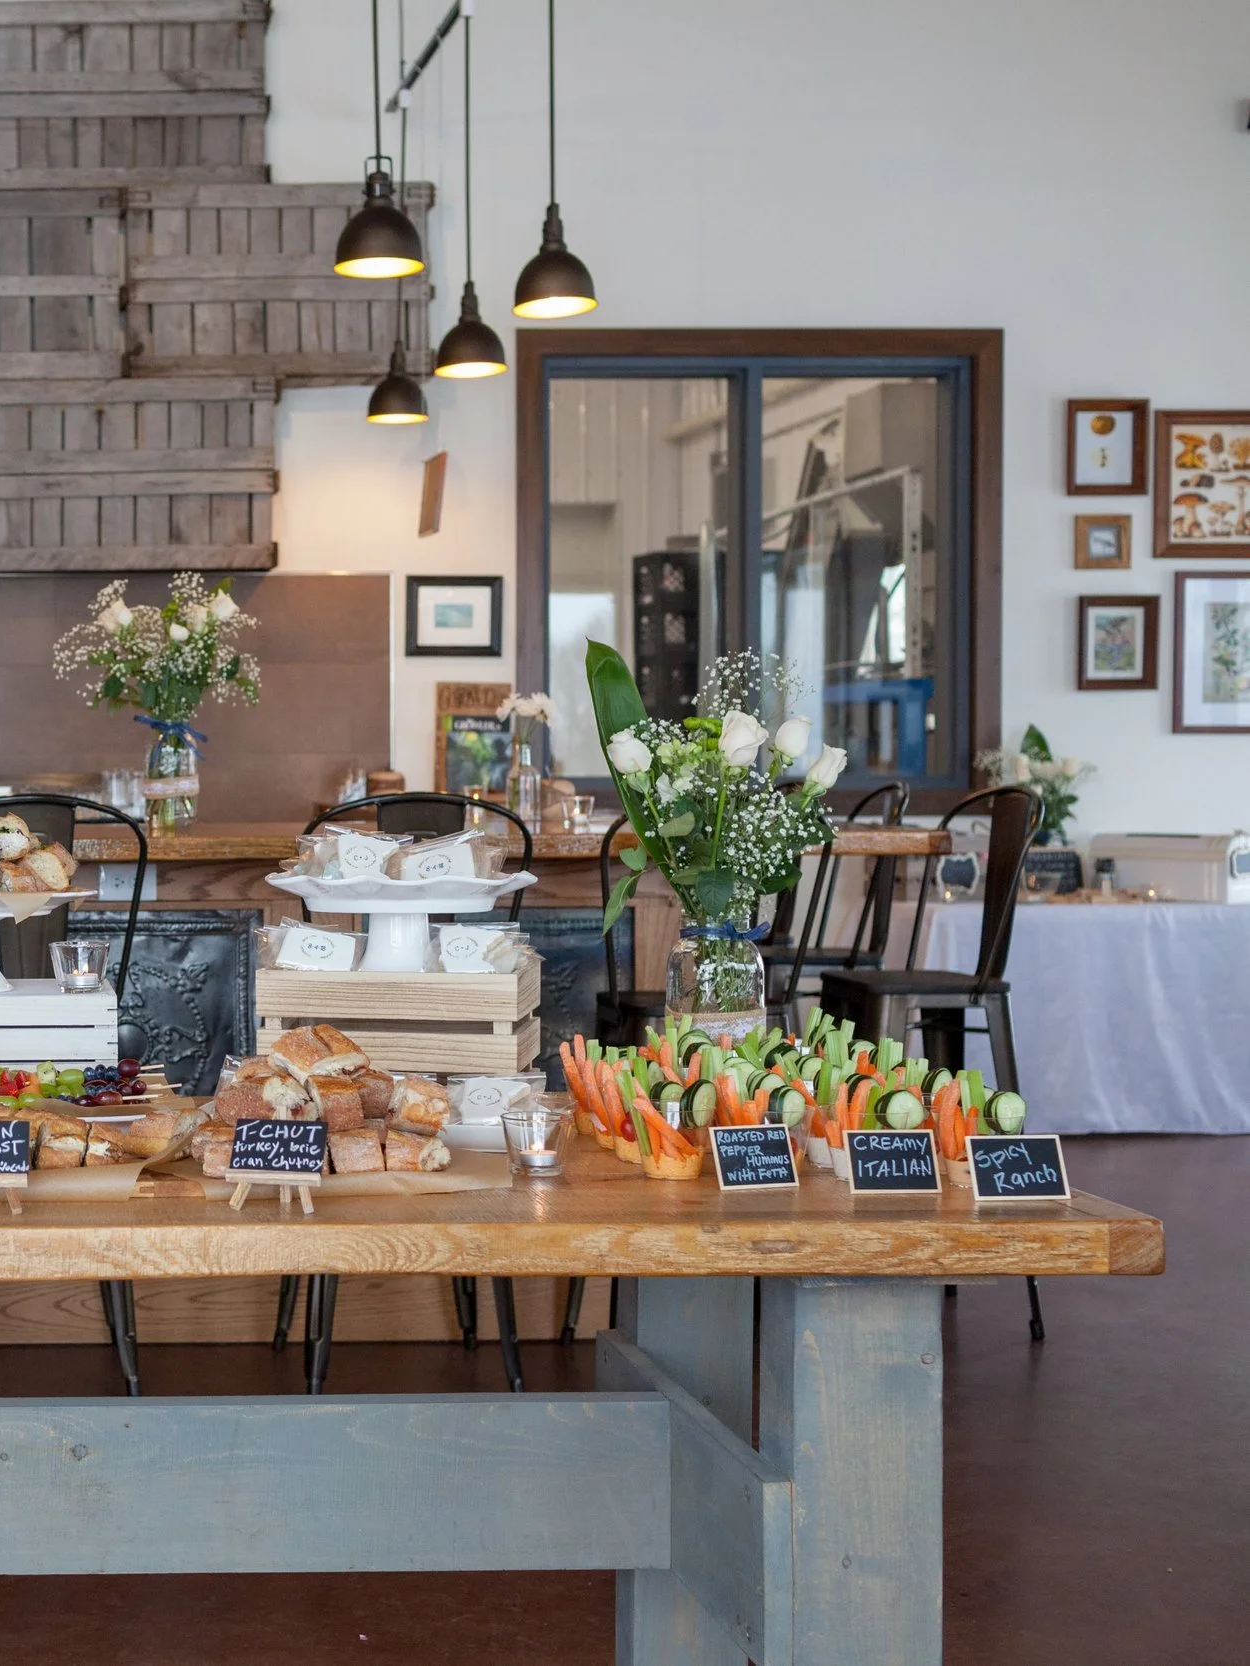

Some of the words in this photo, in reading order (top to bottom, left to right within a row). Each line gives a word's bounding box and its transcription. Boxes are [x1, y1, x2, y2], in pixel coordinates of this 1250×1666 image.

[236, 1120, 323, 1143] T-CHUT
[716, 1130, 765, 1145] ROASTED
[766, 1129, 786, 1140] RED
[290, 1141, 321, 1155] brie
[719, 1144, 764, 1157] PEPPER
[853, 1135, 928, 1155] CREAMY
[232, 1157, 268, 1167] cran.
[271, 1155, 324, 1171] chutney
[746, 1154, 790, 1167] HUMMUS
[858, 1155, 932, 1178] ITALIAN
[993, 1163, 1057, 1193] Ranch
